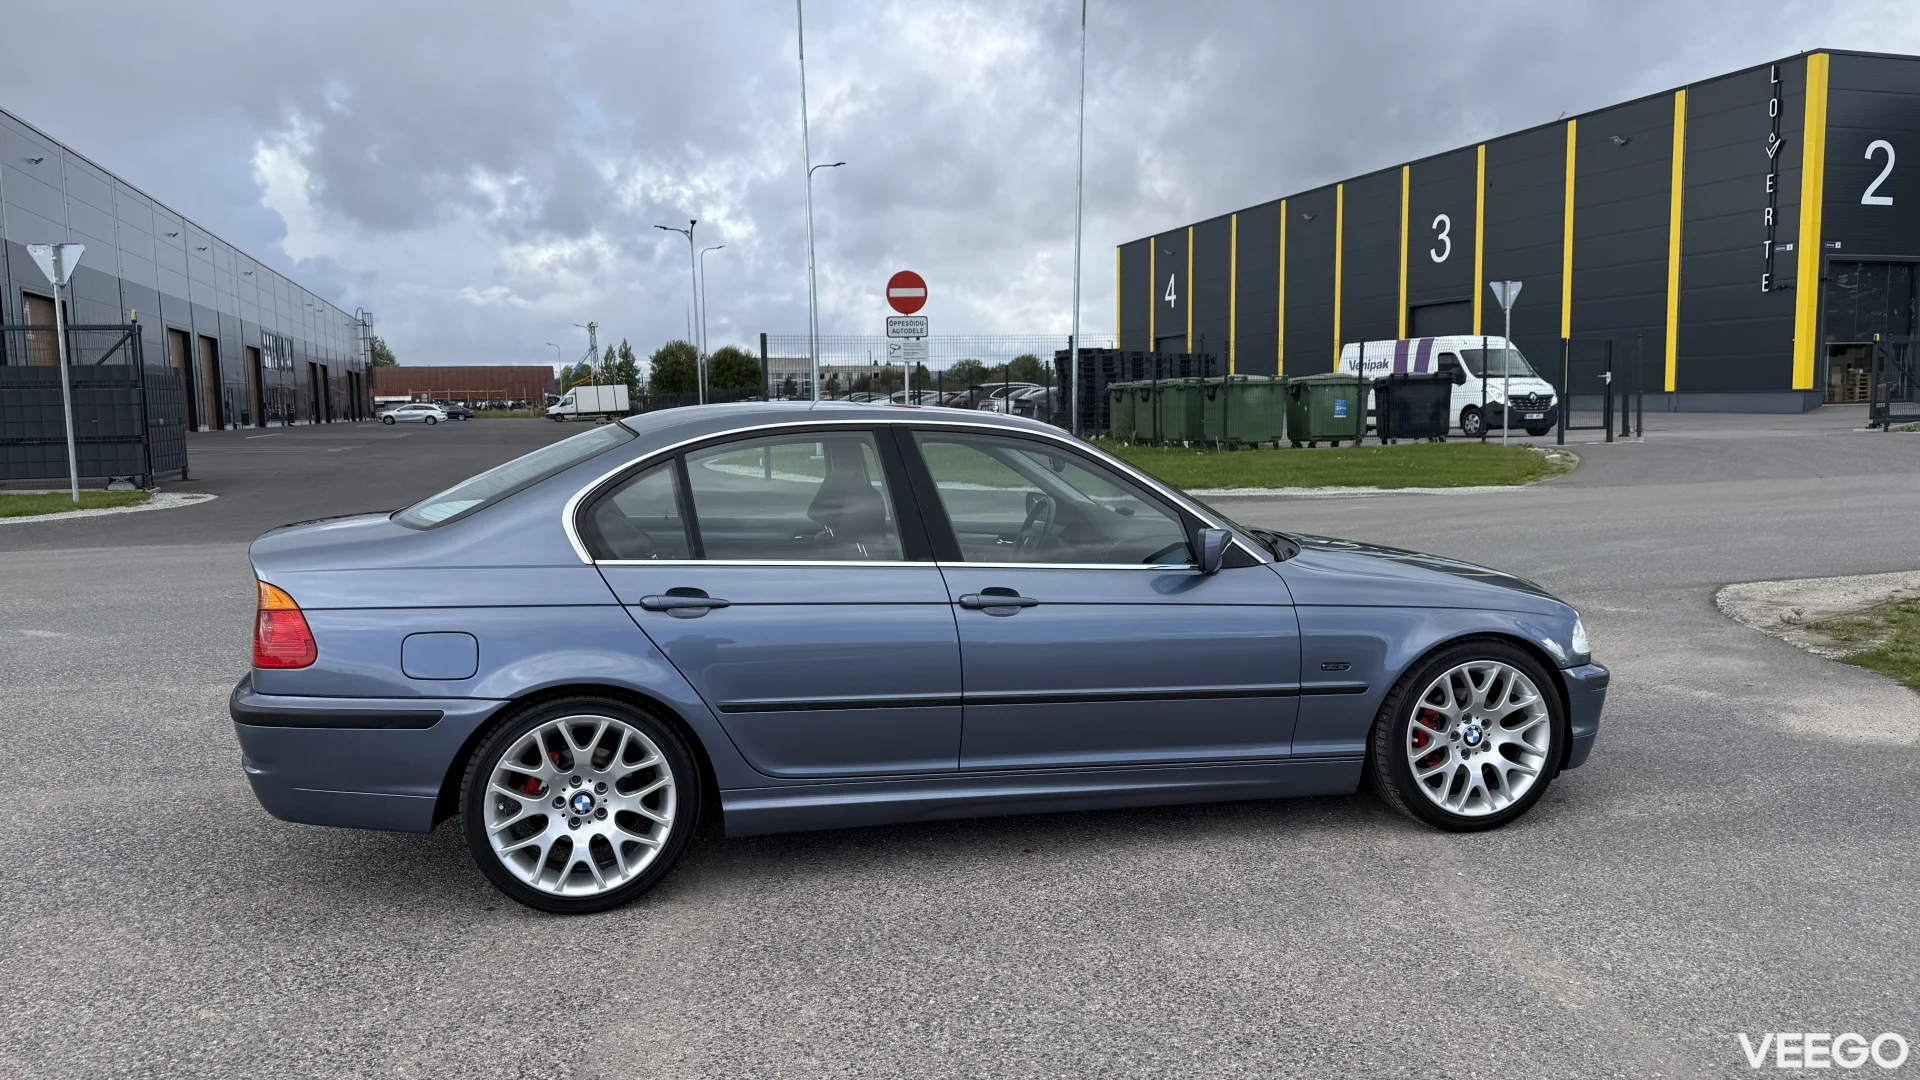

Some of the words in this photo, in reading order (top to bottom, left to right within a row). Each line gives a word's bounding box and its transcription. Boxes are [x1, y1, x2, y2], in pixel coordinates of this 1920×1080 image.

[1861, 140, 1896, 206] 2
[1430, 214, 1451, 263] 3
[1164, 273, 1177, 308] 4
